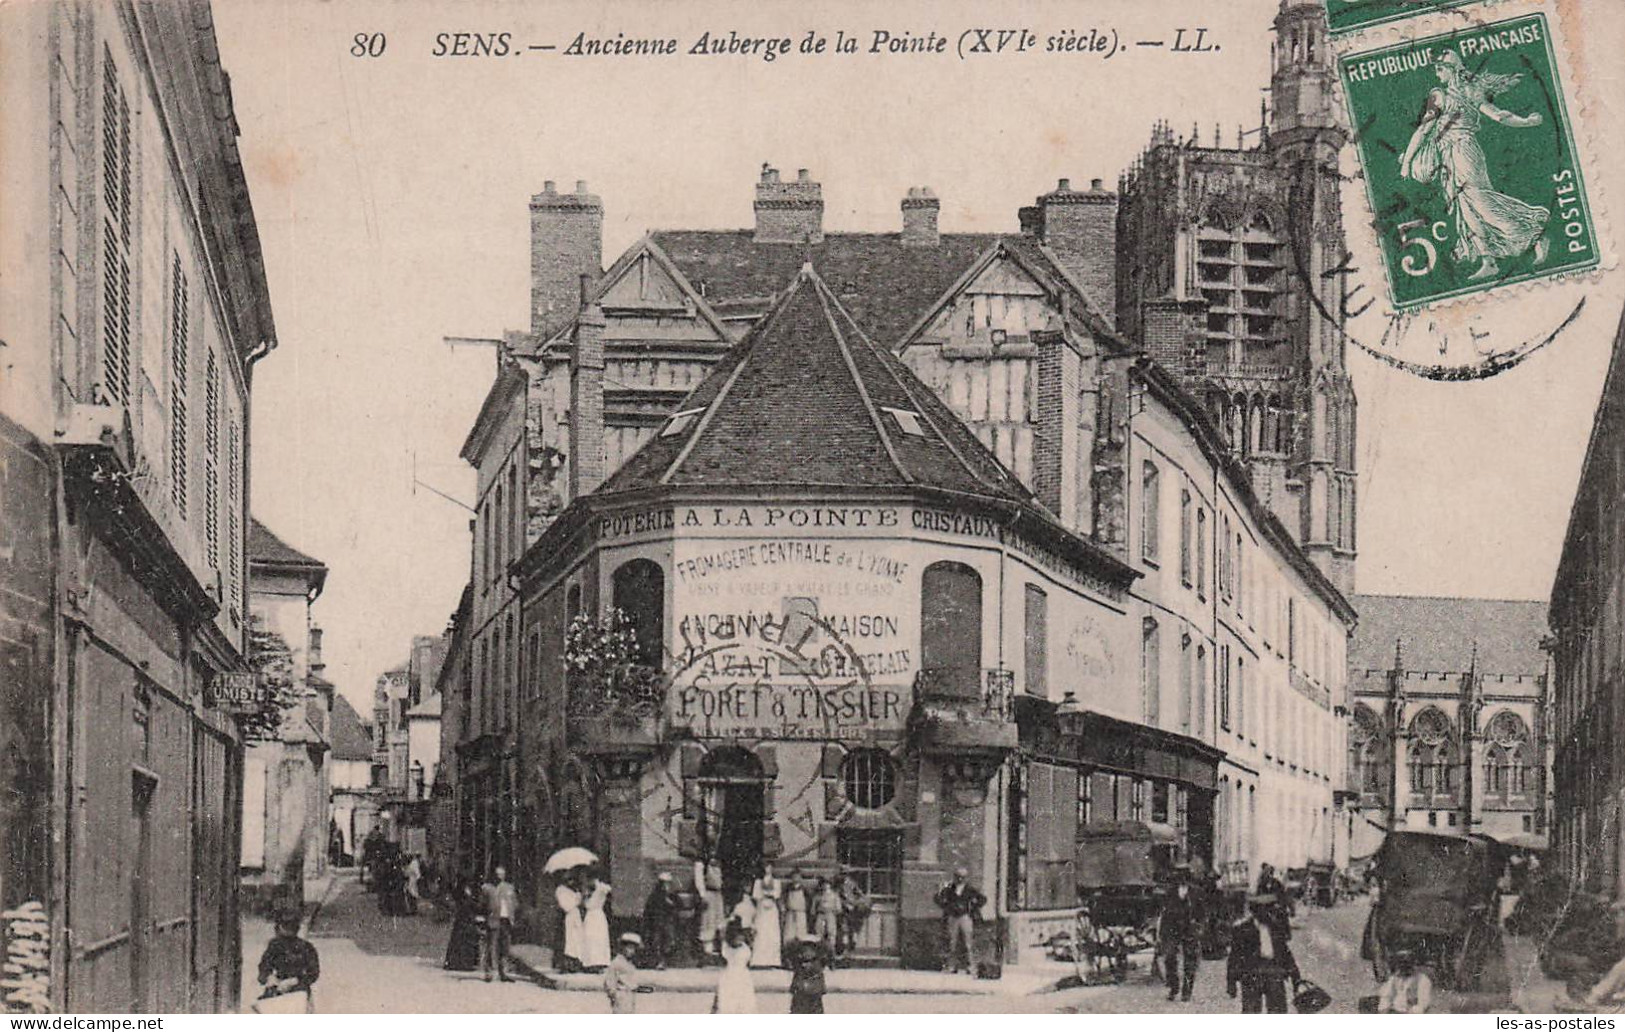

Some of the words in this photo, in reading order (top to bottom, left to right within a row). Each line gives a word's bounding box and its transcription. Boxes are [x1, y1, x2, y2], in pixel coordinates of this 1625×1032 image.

[1459, 23, 1541, 57] FRANÇAISE
[1553, 169, 1587, 253] POSTES
[601, 509, 675, 539] POTERIE
[681, 508, 702, 526] A
[713, 508, 752, 526] LA
[764, 508, 899, 526] POINTE
[912, 509, 996, 538] CRISTAUX
[677, 546, 758, 584] FROMAGERIE
[761, 541, 832, 564] CENTRALE
[682, 614, 774, 637] ANCIENNE
[822, 614, 898, 637] MAISON
[791, 686, 900, 719] TISSIER
